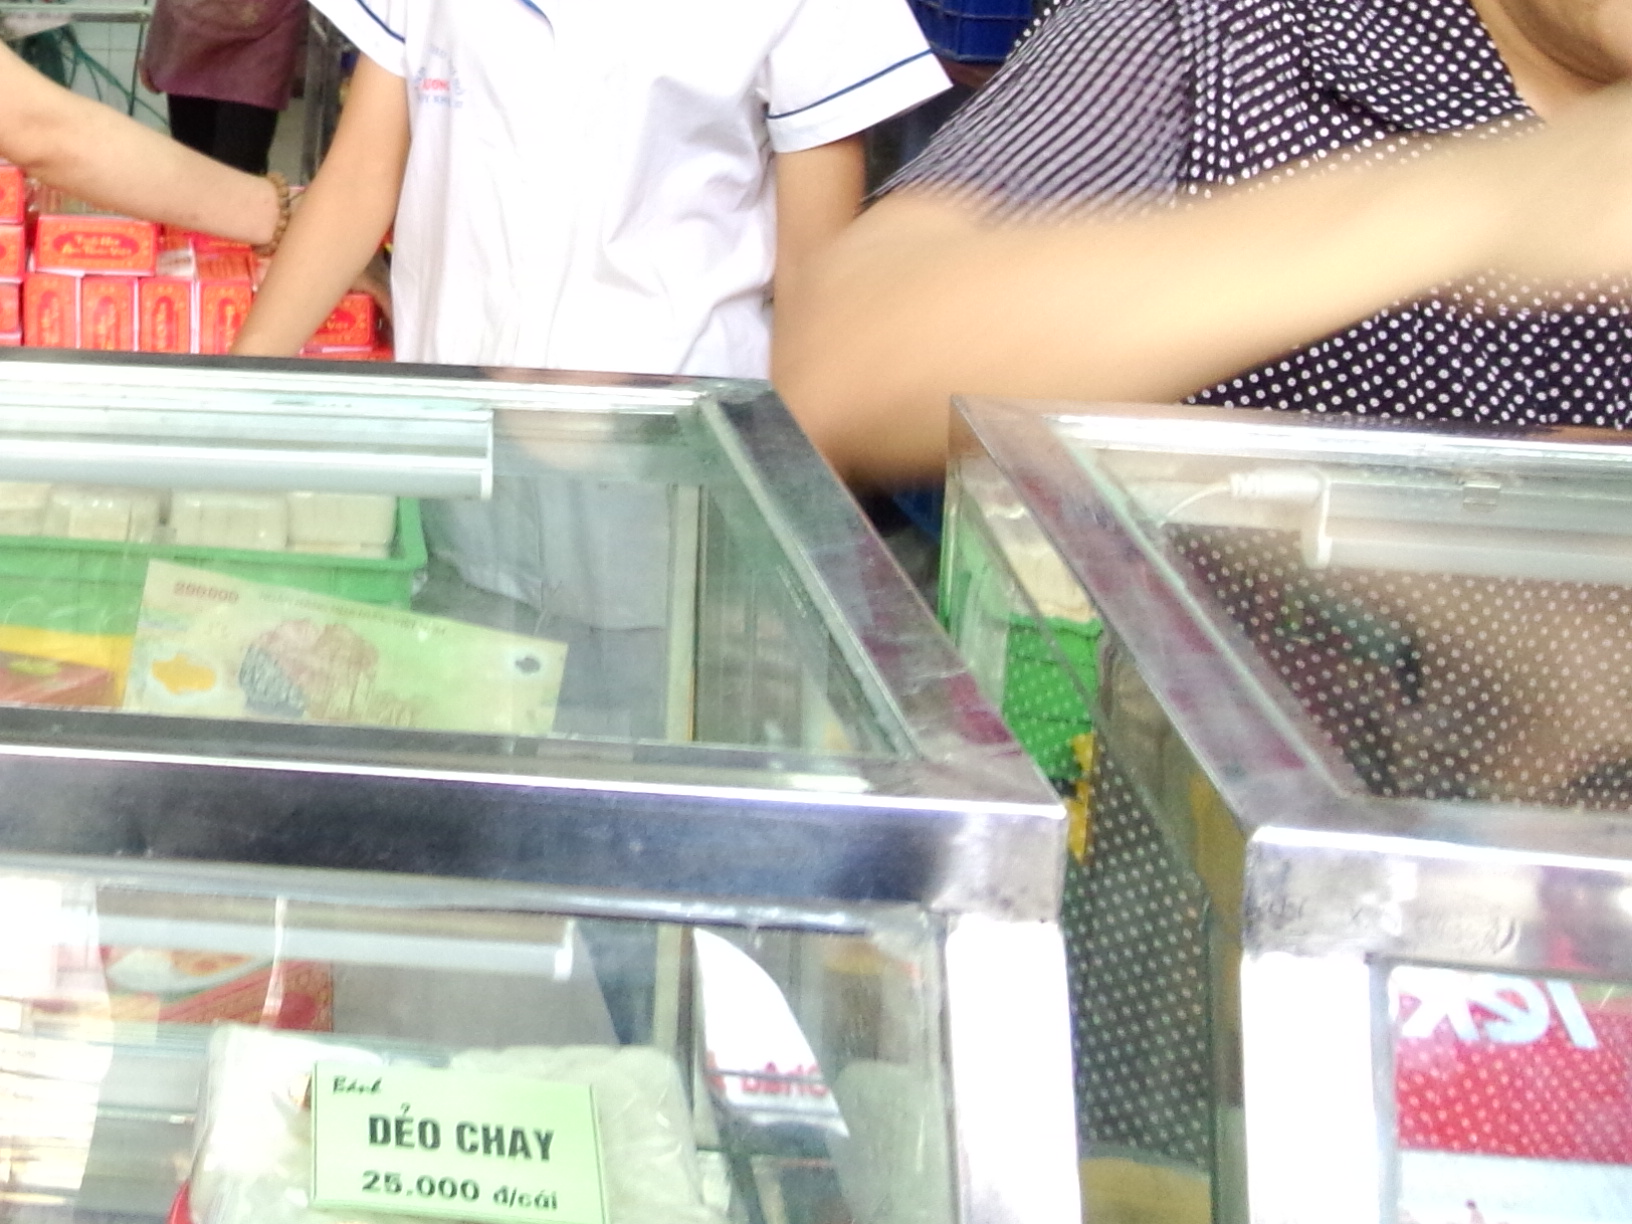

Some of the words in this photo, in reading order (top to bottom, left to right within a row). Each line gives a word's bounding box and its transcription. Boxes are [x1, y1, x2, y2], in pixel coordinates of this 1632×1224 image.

[368, 1101, 443, 1152] DẺO
[455, 1119, 555, 1162] CHAY
[361, 1169, 481, 1203] 25.000
